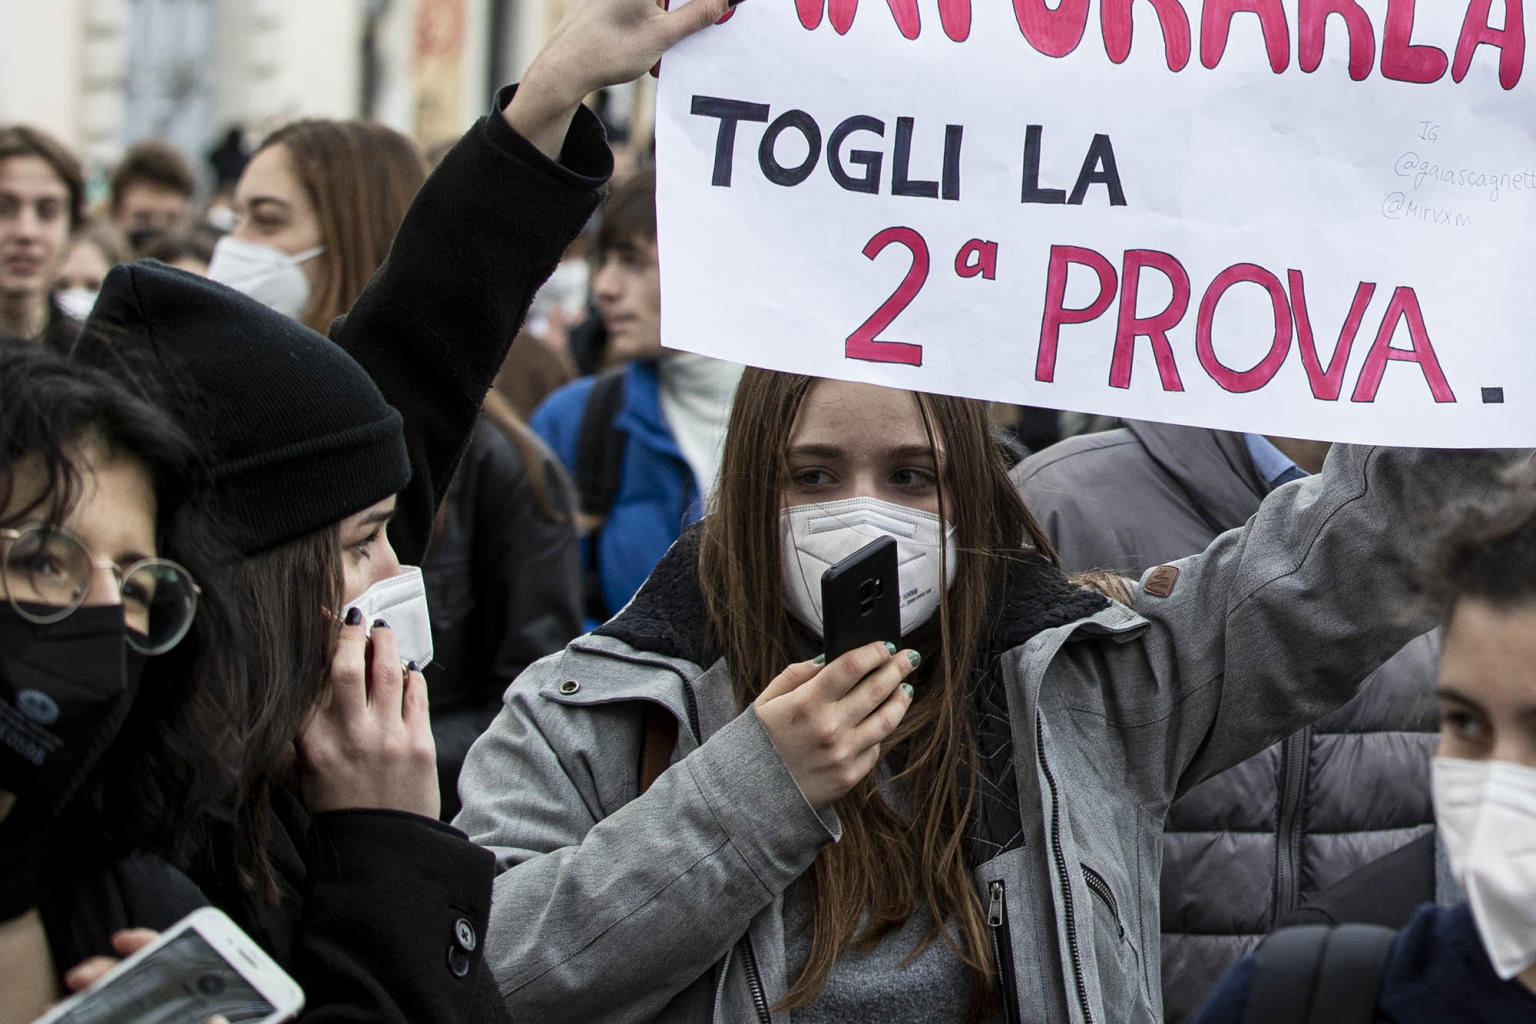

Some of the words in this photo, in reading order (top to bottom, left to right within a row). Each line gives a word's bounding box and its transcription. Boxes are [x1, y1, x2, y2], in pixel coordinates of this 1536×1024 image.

[690, 94, 964, 201] TOGLI
[1020, 124, 1128, 207] LA
[1034, 244, 1505, 405] PROVA.
